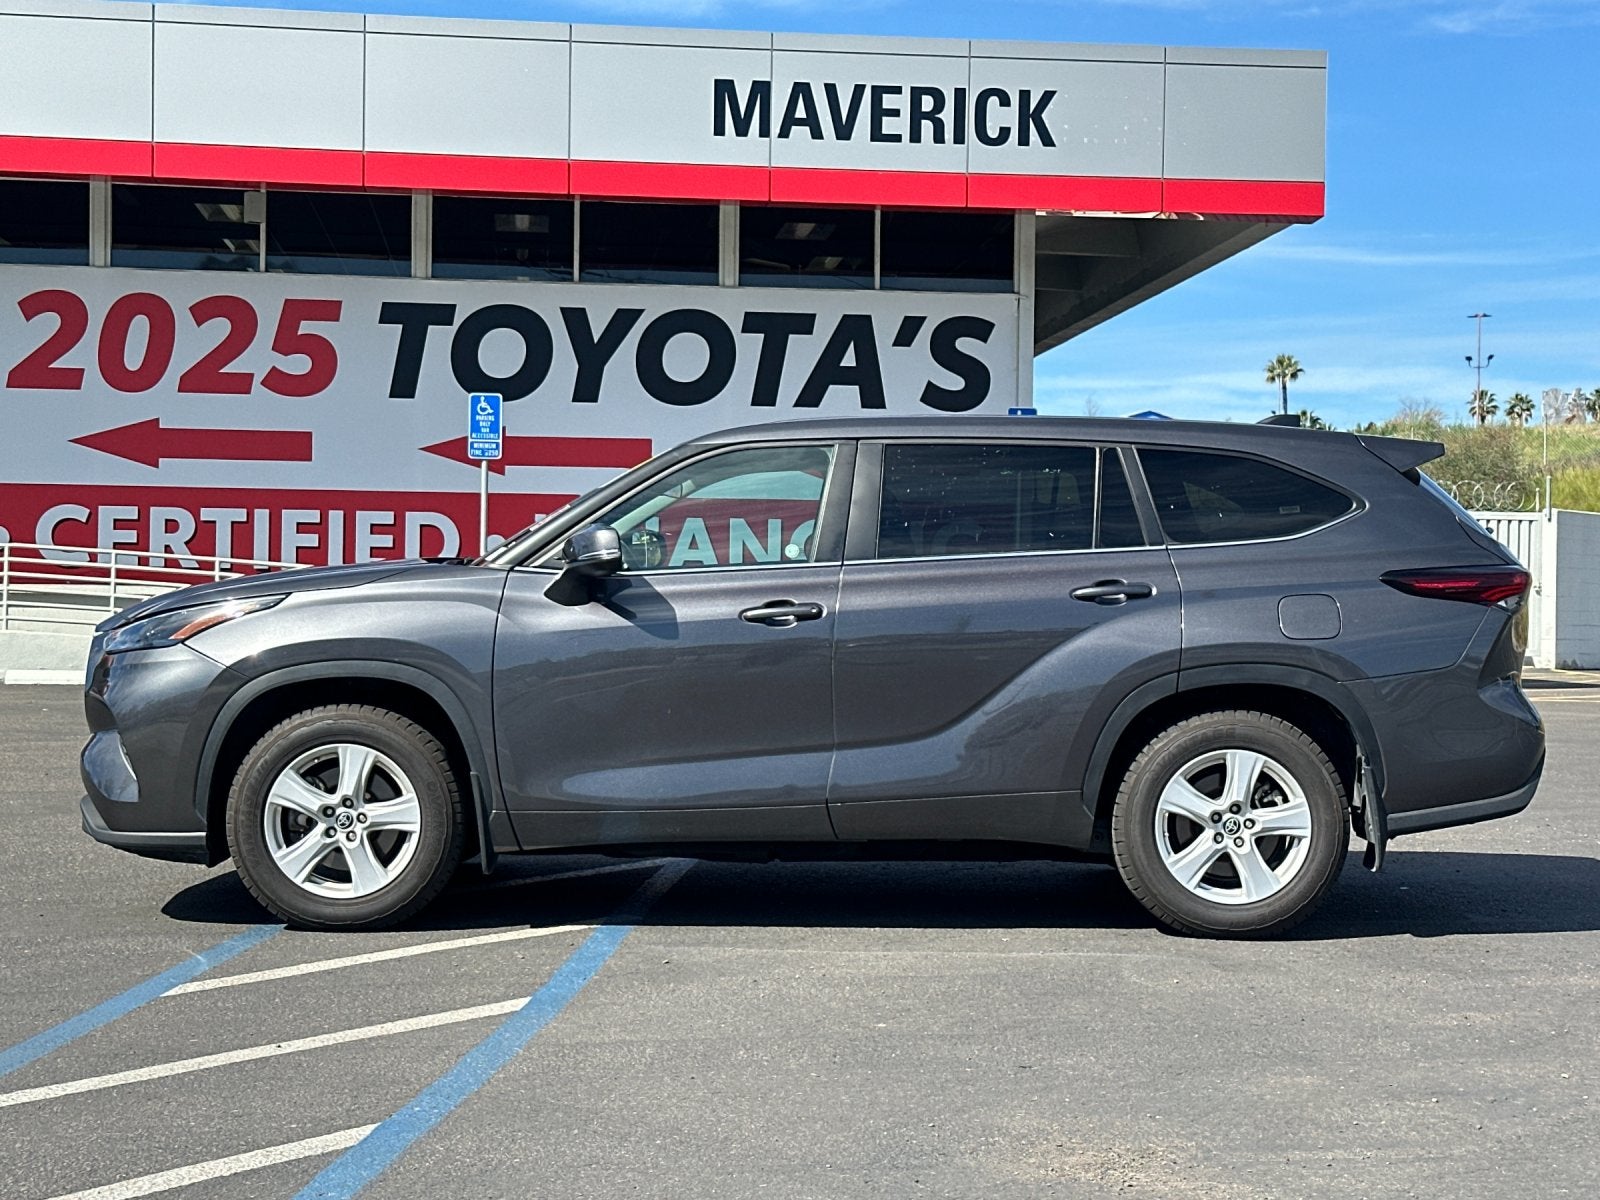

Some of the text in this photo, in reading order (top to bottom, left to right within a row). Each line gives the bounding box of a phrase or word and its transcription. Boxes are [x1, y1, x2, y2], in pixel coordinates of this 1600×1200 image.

[713, 79, 1058, 148] MAVERICK
[7, 290, 996, 413] 2025 TOYOTA'S
[35, 503, 460, 568] CERTIFIED
